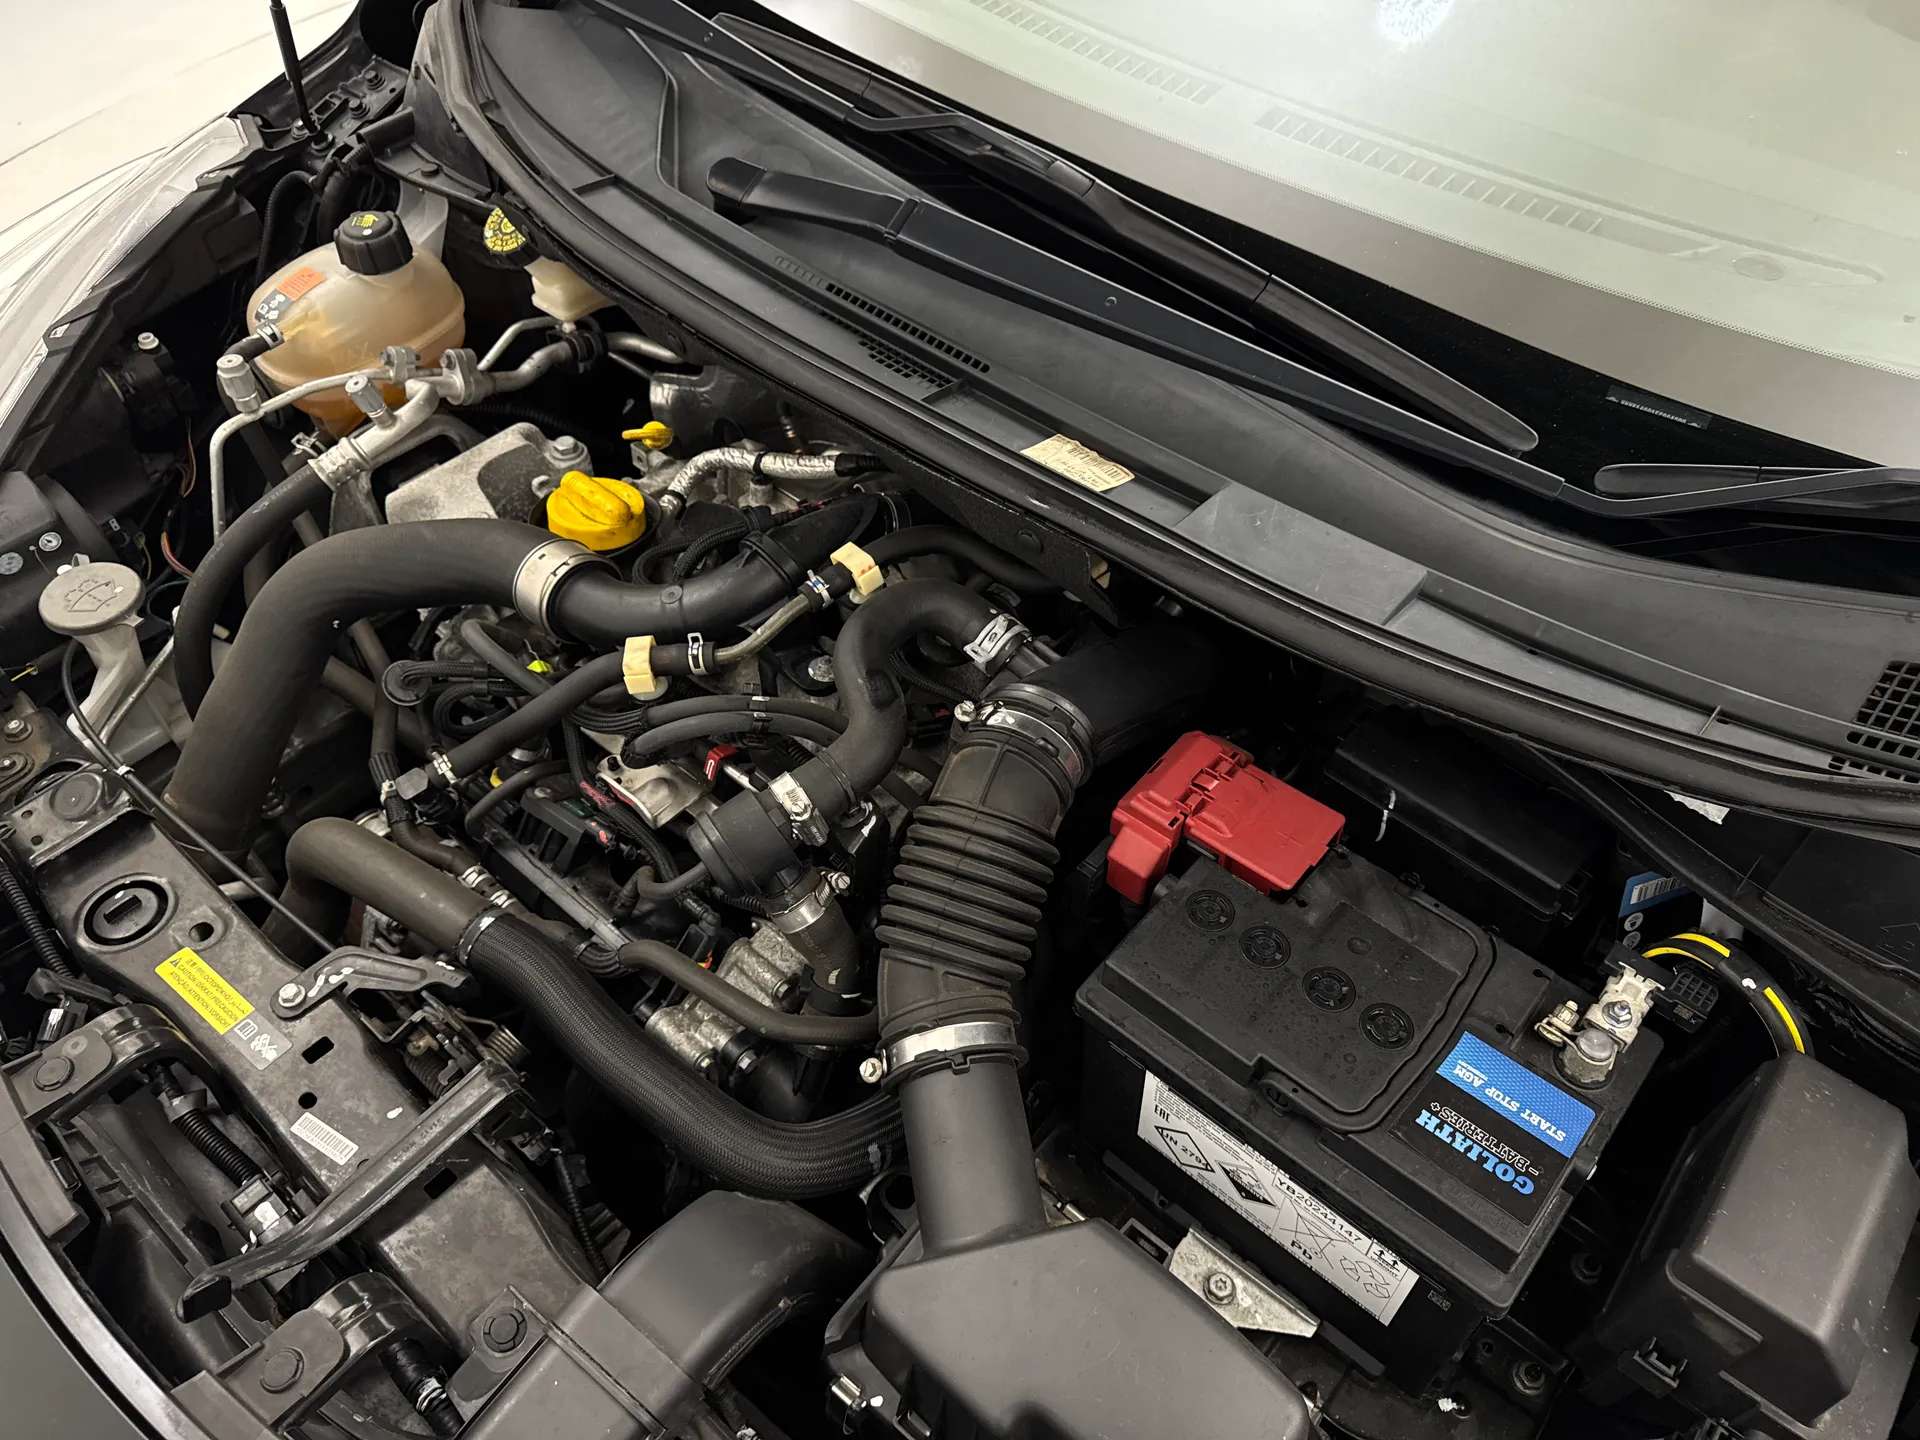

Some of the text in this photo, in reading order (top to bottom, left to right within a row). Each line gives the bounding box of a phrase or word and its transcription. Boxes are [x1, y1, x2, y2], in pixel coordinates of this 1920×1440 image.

[1453, 1064, 1566, 1142] START STOP AGM
[1415, 1108, 1535, 1195] GOLIATH
[1277, 1177, 1362, 1242] YB20244147
[1290, 1239, 1313, 1260] Pb
